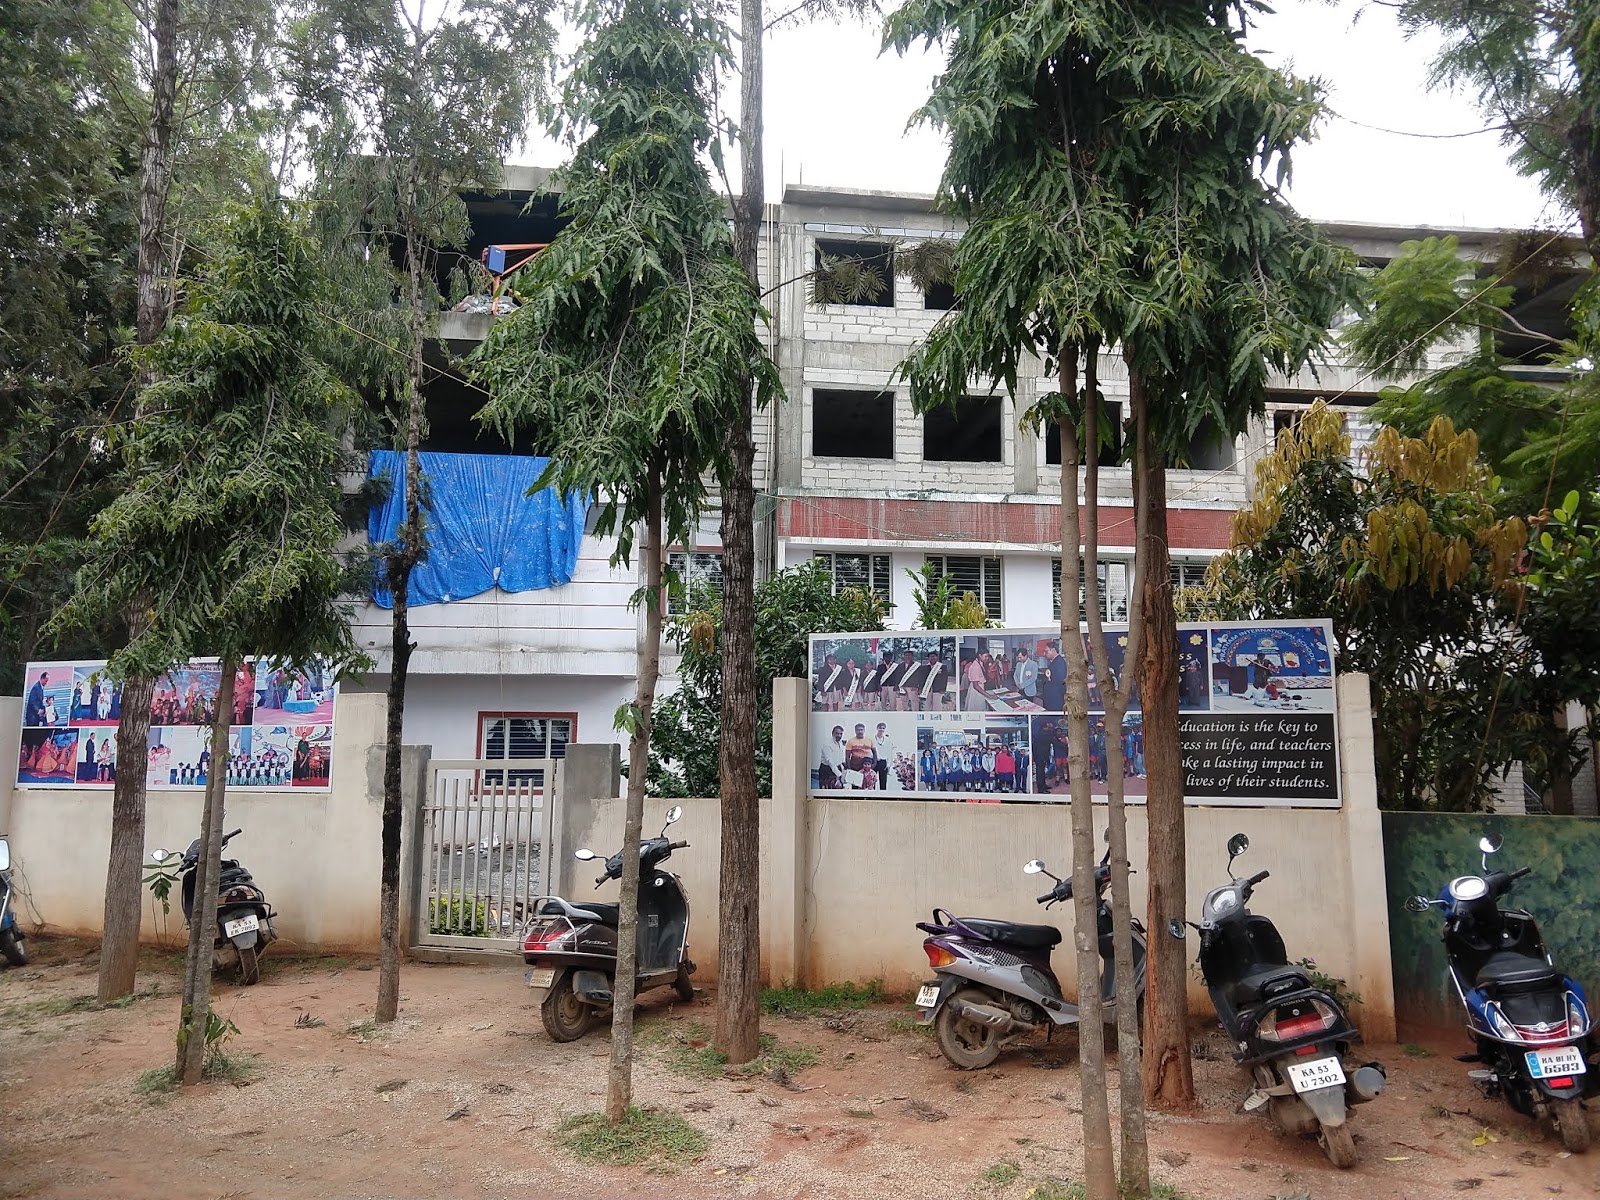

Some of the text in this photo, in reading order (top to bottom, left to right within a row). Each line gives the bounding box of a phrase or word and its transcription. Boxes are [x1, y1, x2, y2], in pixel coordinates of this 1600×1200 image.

[1238, 628, 1296, 640] INTERNATIONAL
[1296, 638, 1316, 661] SCHOOL
[1239, 720, 1250, 732] is
[1254, 719, 1274, 732] the
[1277, 719, 1300, 737] key
[1304, 721, 1318, 732] to
[1205, 739, 1218, 751] in
[1221, 737, 1246, 755] life,
[1250, 738, 1277, 751] and
[1279, 738, 1332, 751] teachers
[1202, 759, 1211, 769] a
[1214, 756, 1258, 774] lasting
[1261, 757, 1306, 774] impact
[1310, 757, 1324, 770] in
[1186, 773, 1330, 791] lives of their students.
[1280, 998, 1306, 1007] HONDA
[1541, 1056, 1554, 1064] KA
[1544, 1062, 1580, 1074] 6583
[1301, 1065, 1329, 1077] KA 53
[1300, 1073, 1339, 1088] U 7302
